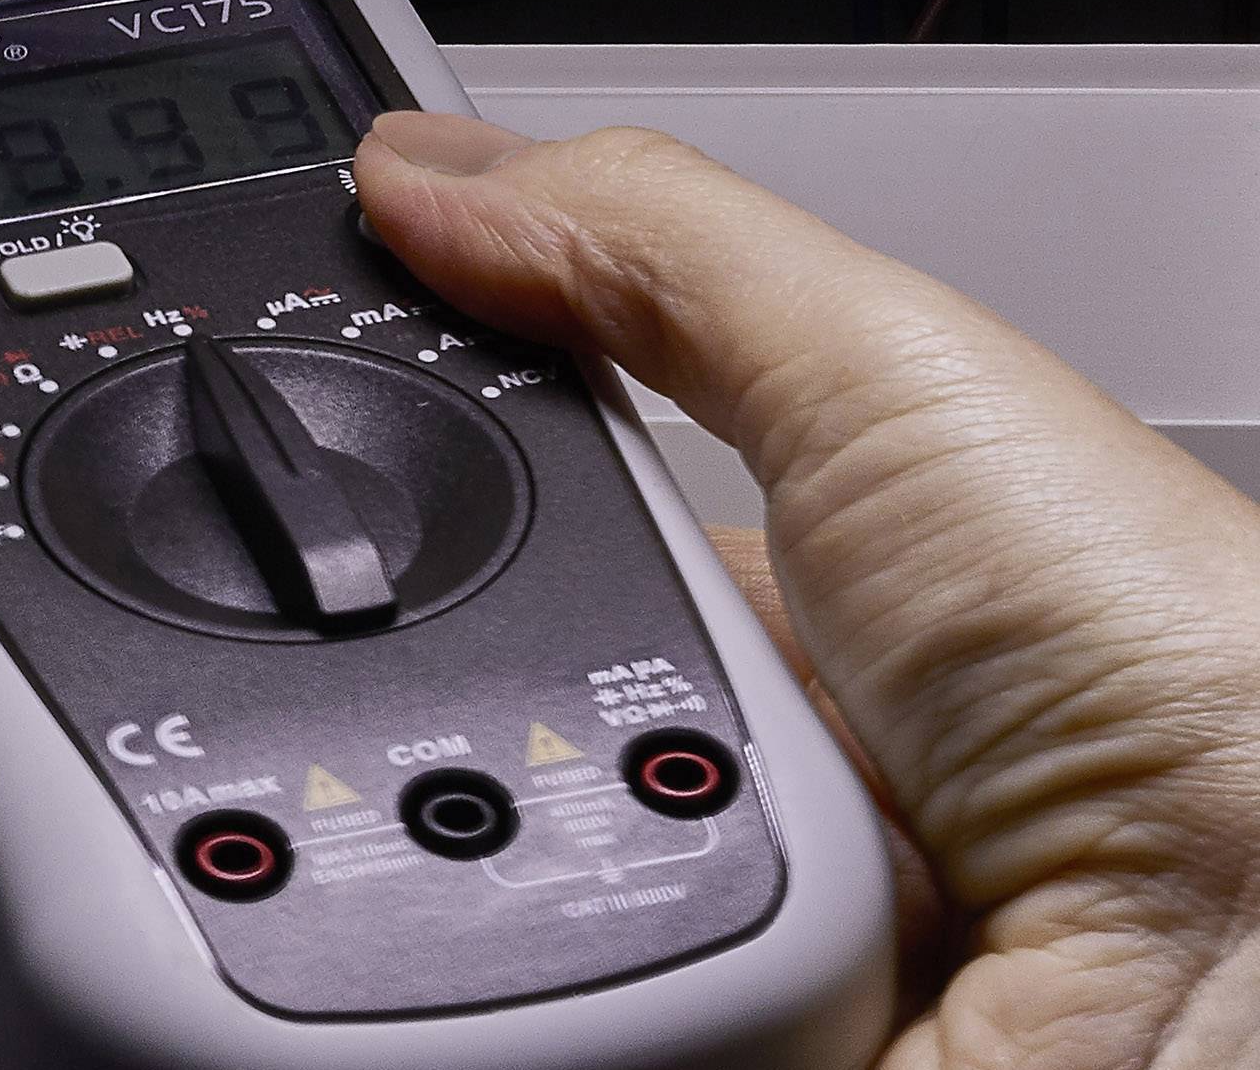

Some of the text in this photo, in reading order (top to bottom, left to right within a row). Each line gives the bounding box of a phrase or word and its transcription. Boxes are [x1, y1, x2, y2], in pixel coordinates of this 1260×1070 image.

[350, 302, 409, 327] mA
[106, 714, 206, 766] CE
[387, 733, 473, 767] COM
